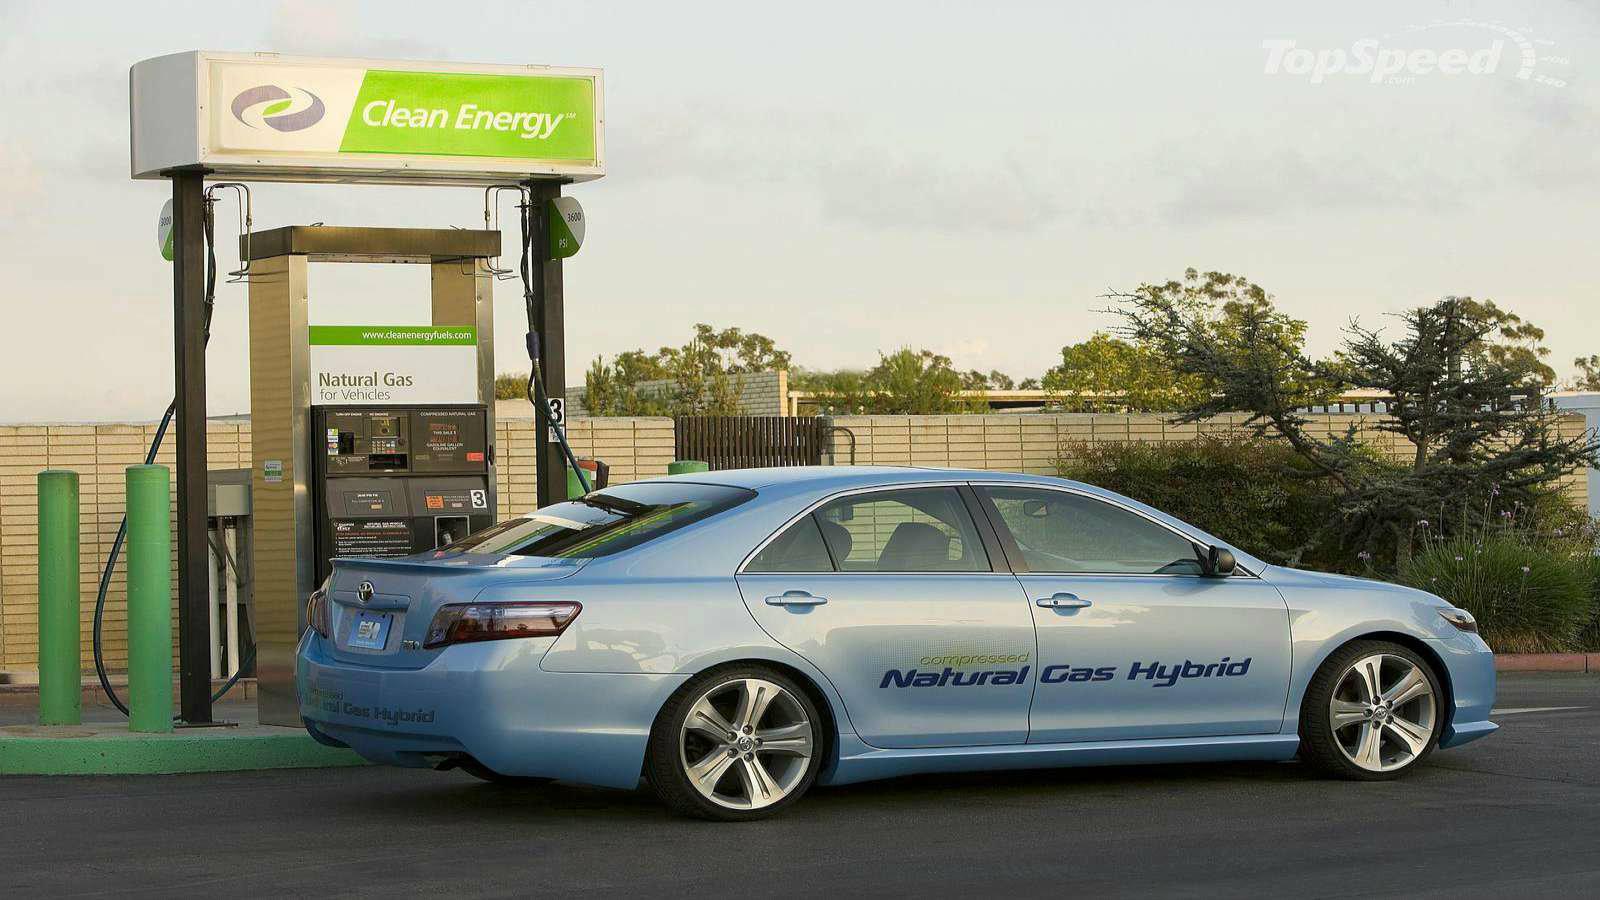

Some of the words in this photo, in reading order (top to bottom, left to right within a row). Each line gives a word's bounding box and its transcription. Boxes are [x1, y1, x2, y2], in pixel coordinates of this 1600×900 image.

[362, 98, 449, 129] Clean
[454, 103, 565, 140] Energy
[567, 212, 582, 223] 3600
[558, 238, 568, 249] PSI
[362, 330, 472, 341] www.cleanenergyfuels.com
[319, 371, 378, 387] Natural
[383, 372, 413, 387] Gas
[320, 388, 337, 401] for
[341, 388, 391, 401] Vehicles
[549, 399, 563, 424] 3
[472, 490, 485, 507] 3
[920, 651, 1030, 668] compressed
[879, 665, 1031, 689] Natural
[1039, 664, 1118, 684] Gas
[1126, 656, 1253, 688] Hybrid
[343, 702, 370, 718] Gas
[374, 704, 436, 726] Hybrid
